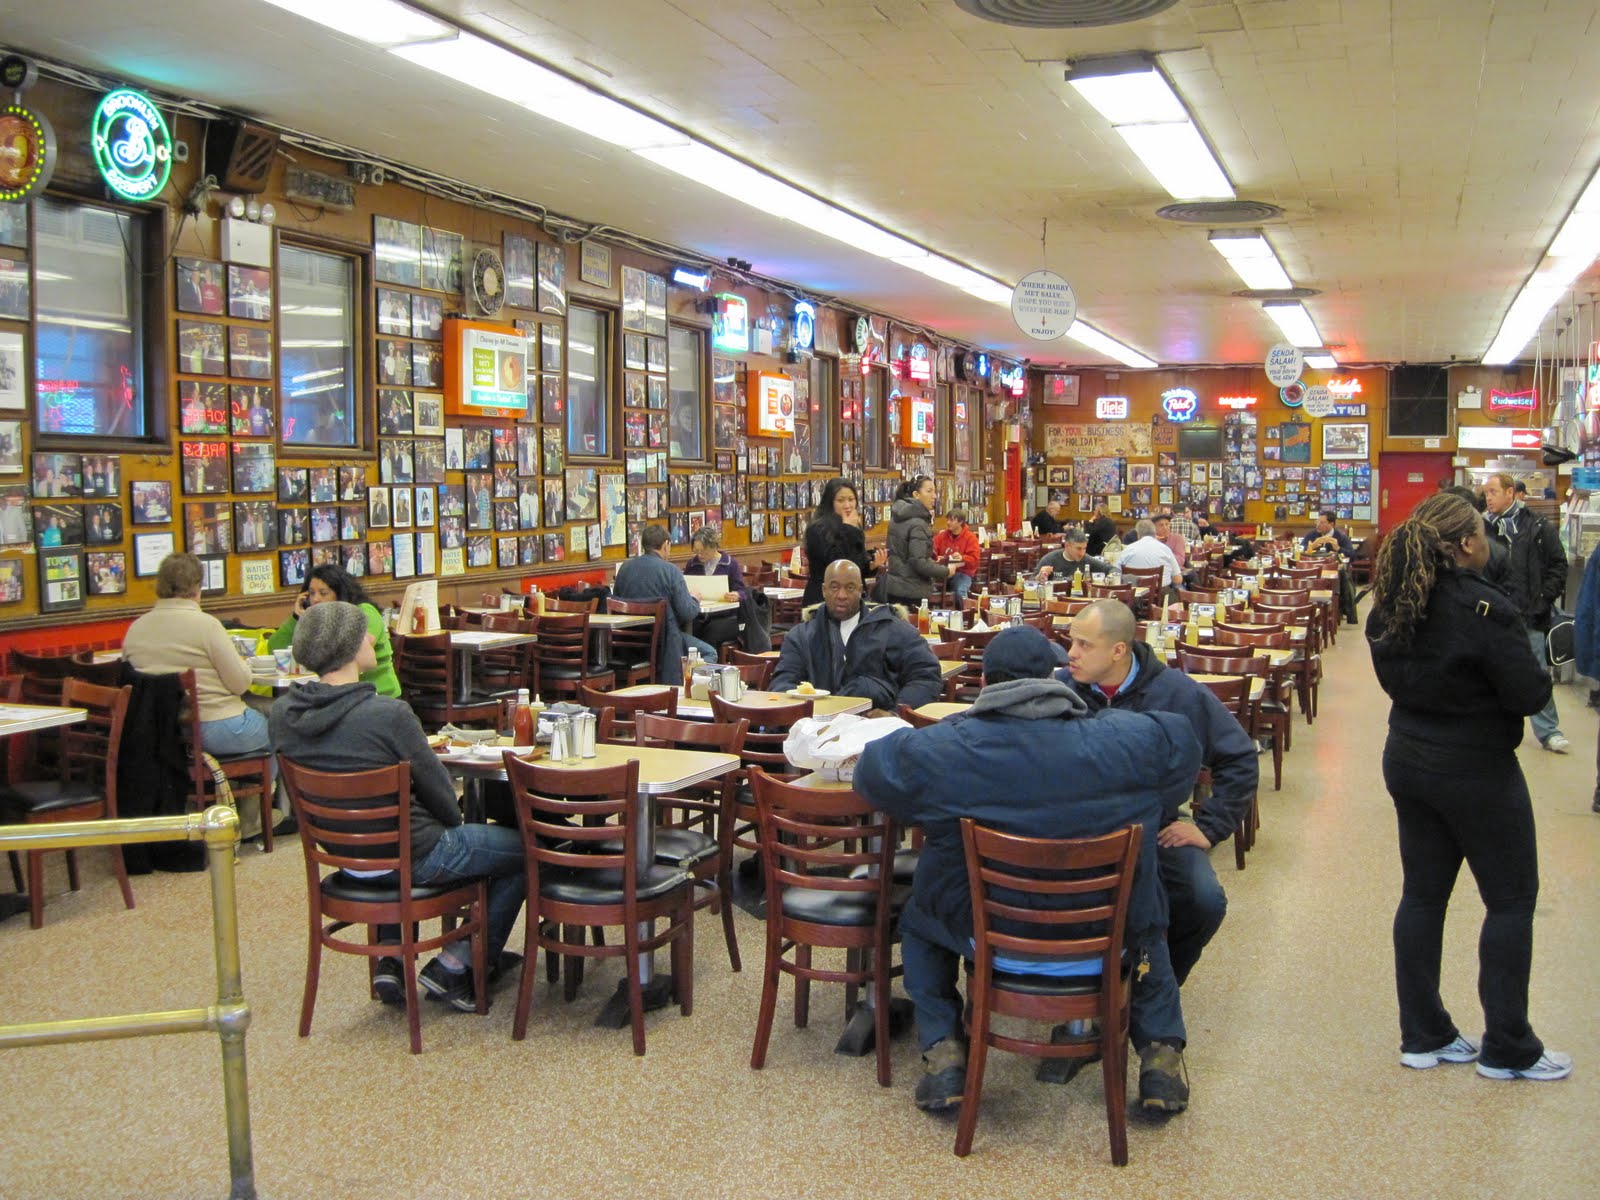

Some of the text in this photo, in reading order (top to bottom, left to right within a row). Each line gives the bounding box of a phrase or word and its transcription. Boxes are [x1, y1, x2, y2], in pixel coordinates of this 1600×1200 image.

[103, 95, 160, 131] BROOKLYN
[1021, 281, 1069, 291] WHERE HARRY
[1018, 297, 1037, 305] HOPE
[1269, 357, 1297, 366] SALAMI
[1491, 395, 1533, 406] Budweiser
[1328, 406, 1361, 416] ATM
[1048, 426, 1125, 437] FOR YOUR BUSINESS
[1065, 437, 1098, 447] HOLIDAY
[246, 565, 270, 573] WAITER
[246, 573, 270, 581] SERVICE
